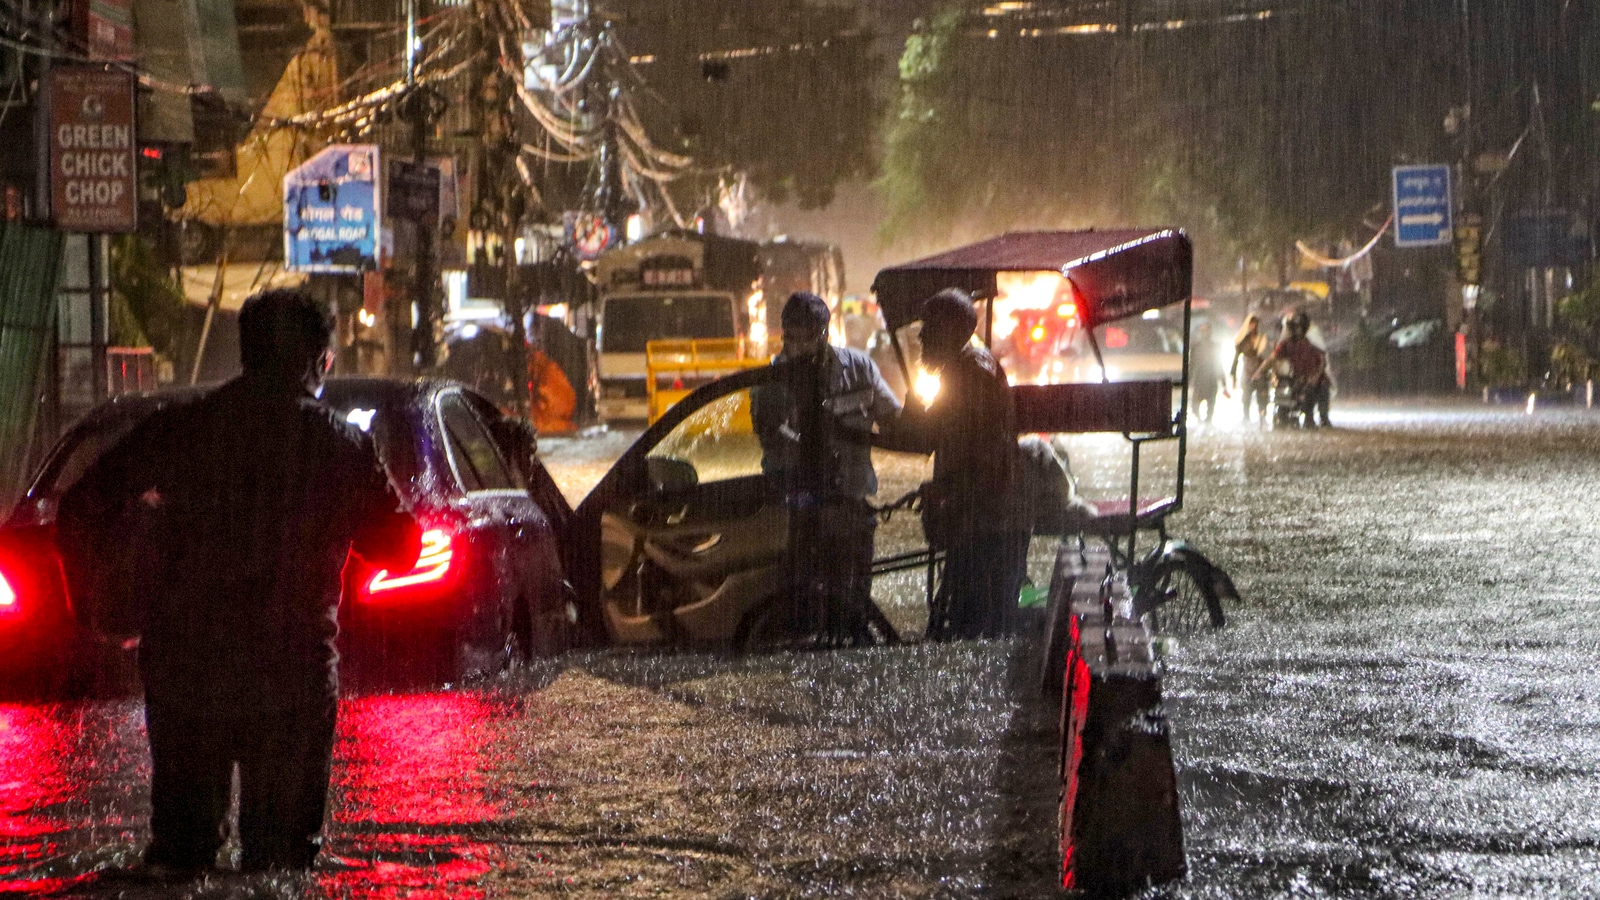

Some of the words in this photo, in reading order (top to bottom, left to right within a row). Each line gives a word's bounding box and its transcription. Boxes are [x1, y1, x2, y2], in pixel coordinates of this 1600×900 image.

[58, 124, 129, 148] GREEN
[60, 152, 129, 177] CHICK
[65, 180, 124, 204] CHOP
[339, 226, 367, 241] ROAD
